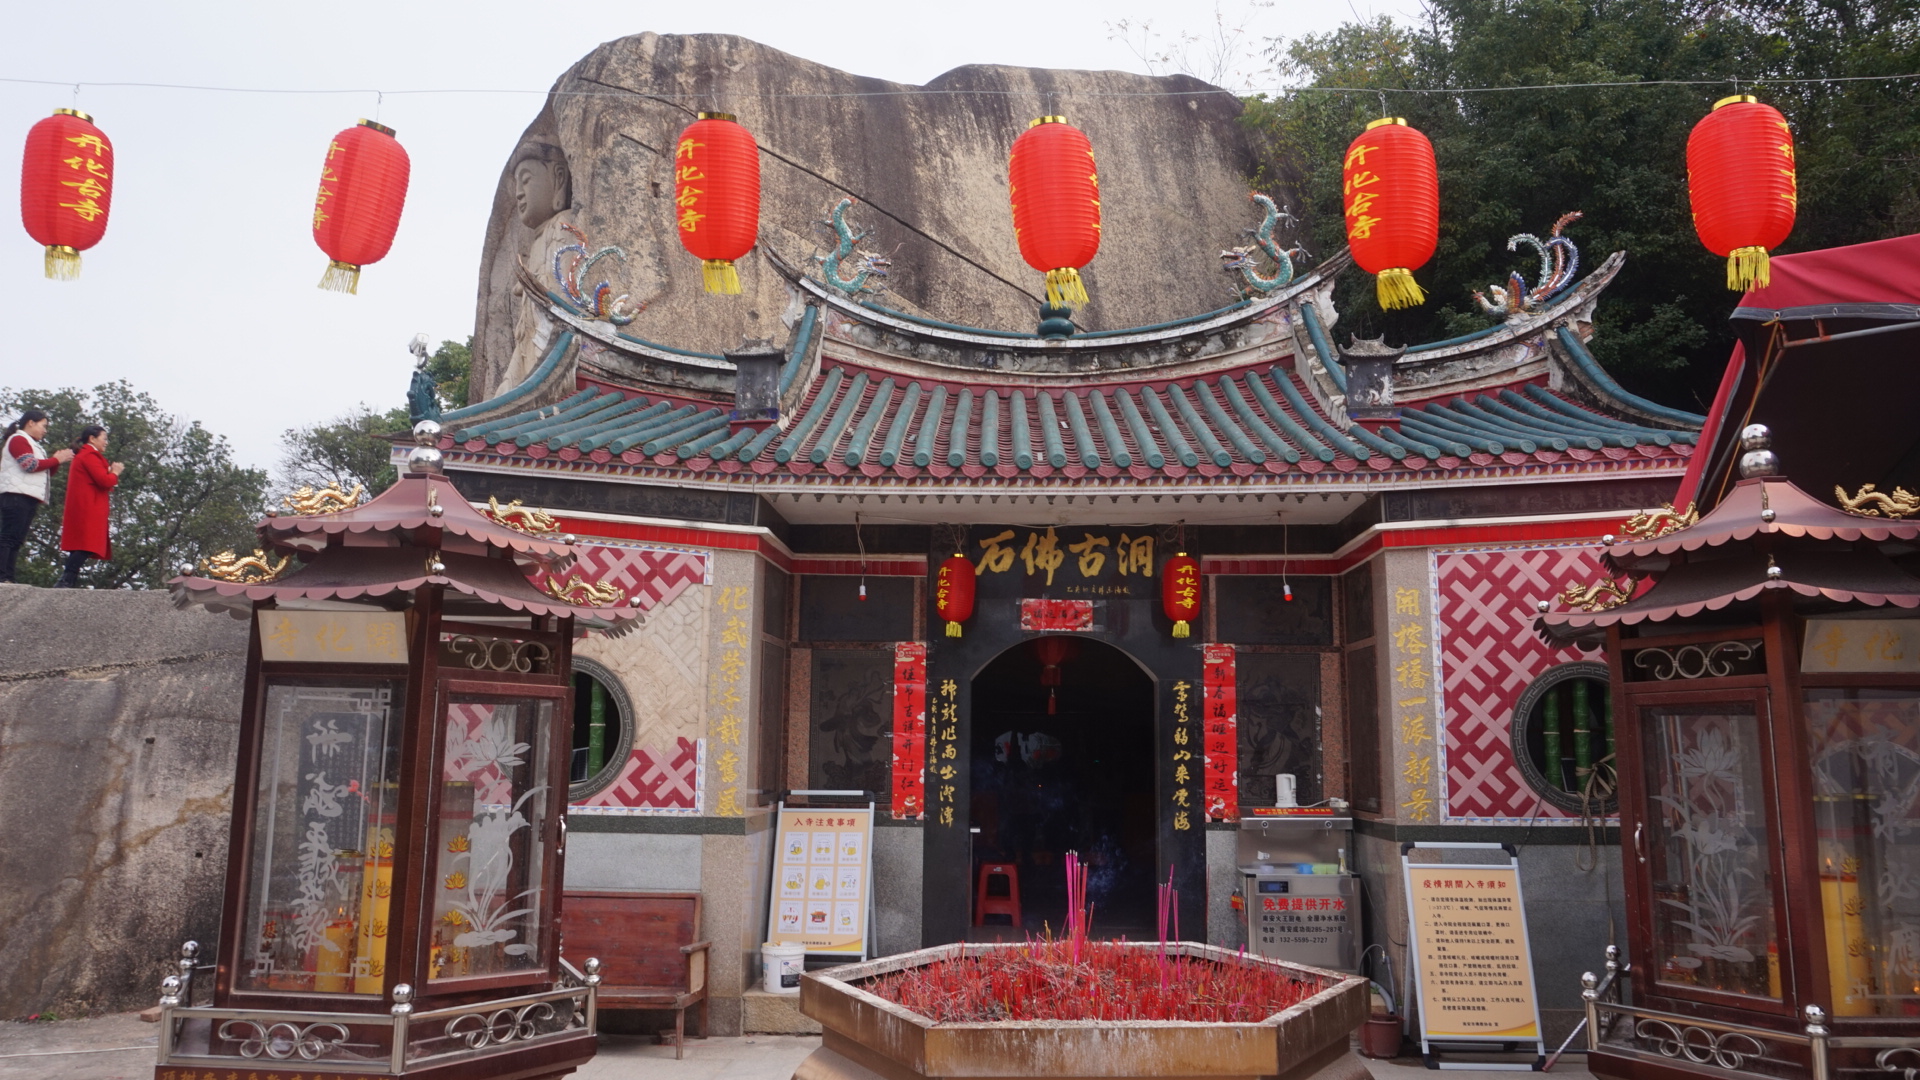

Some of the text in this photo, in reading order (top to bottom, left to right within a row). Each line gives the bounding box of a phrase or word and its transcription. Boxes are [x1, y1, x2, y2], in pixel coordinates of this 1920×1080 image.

[975, 526, 1155, 586] 石佛古洞
[1263, 898, 1347, 911] 免费提供开水
